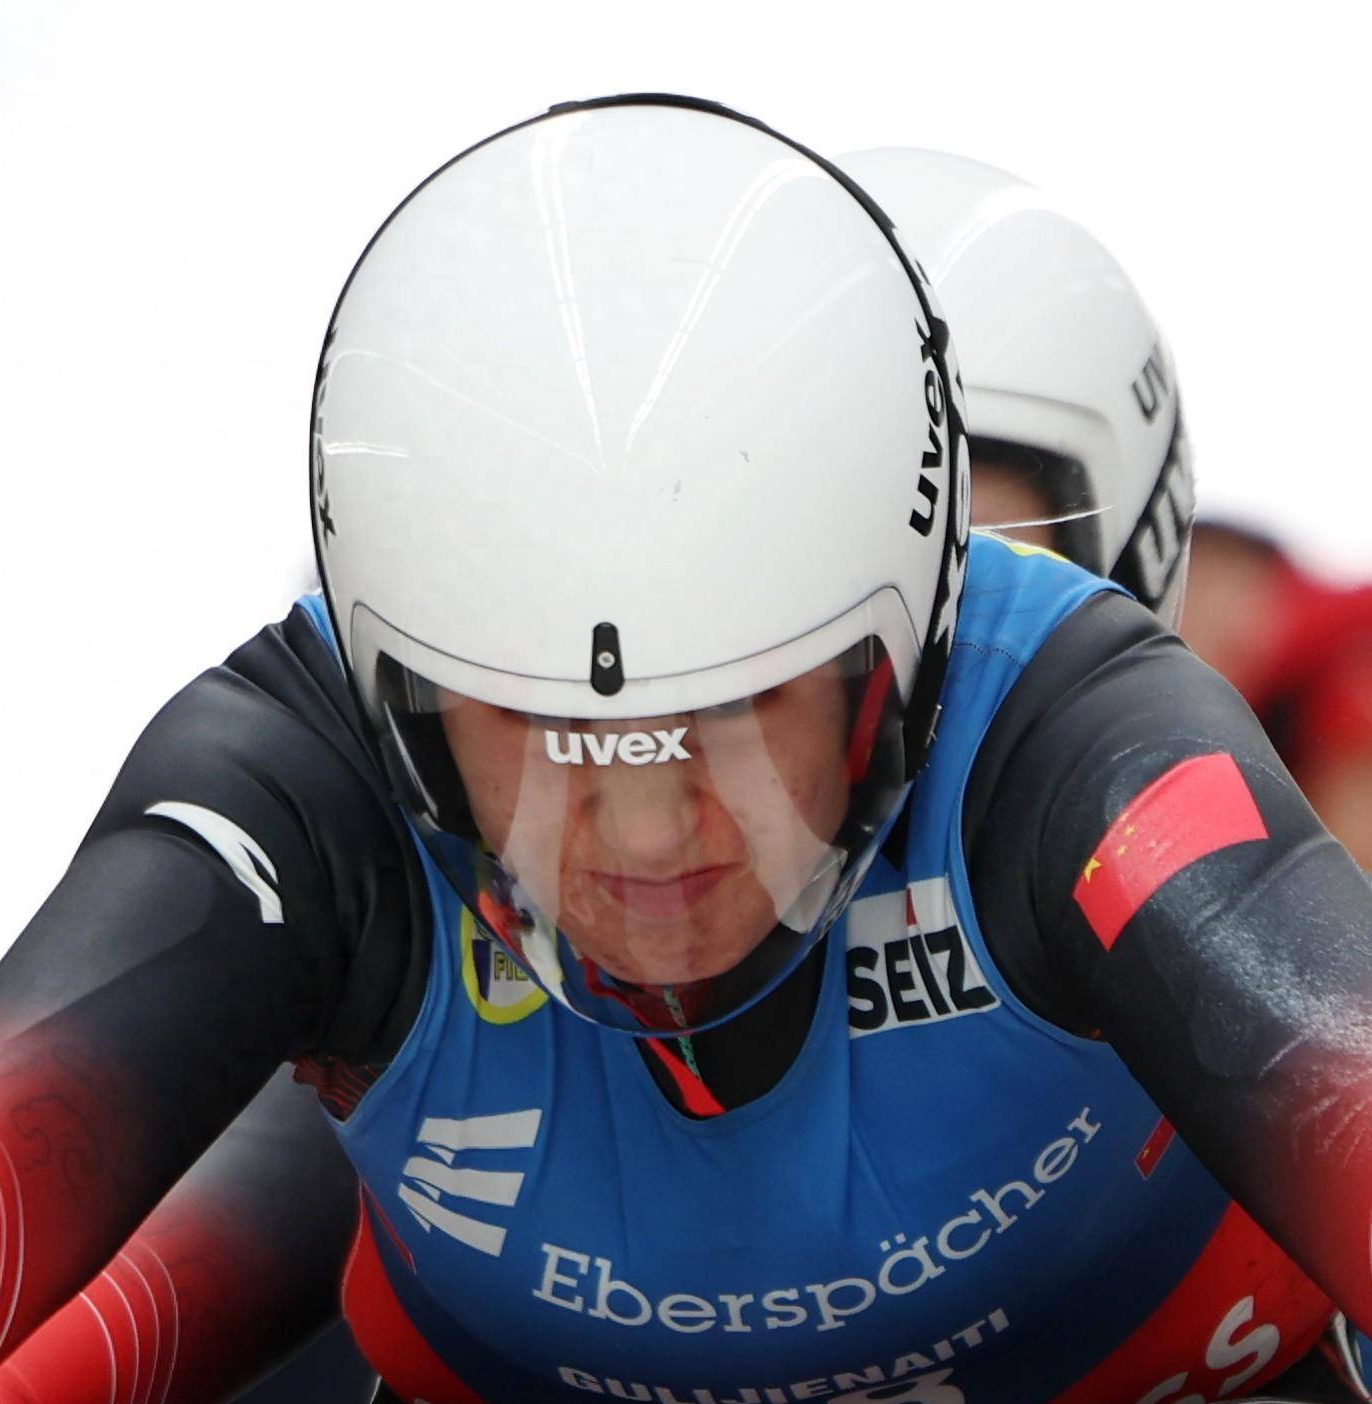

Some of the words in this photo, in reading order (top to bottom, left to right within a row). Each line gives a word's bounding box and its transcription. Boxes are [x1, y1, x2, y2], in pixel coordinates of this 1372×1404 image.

[544, 726, 693, 767] uvex
[845, 925, 998, 1031] SEIZ
[532, 1106, 1102, 1333] Eberspächer
